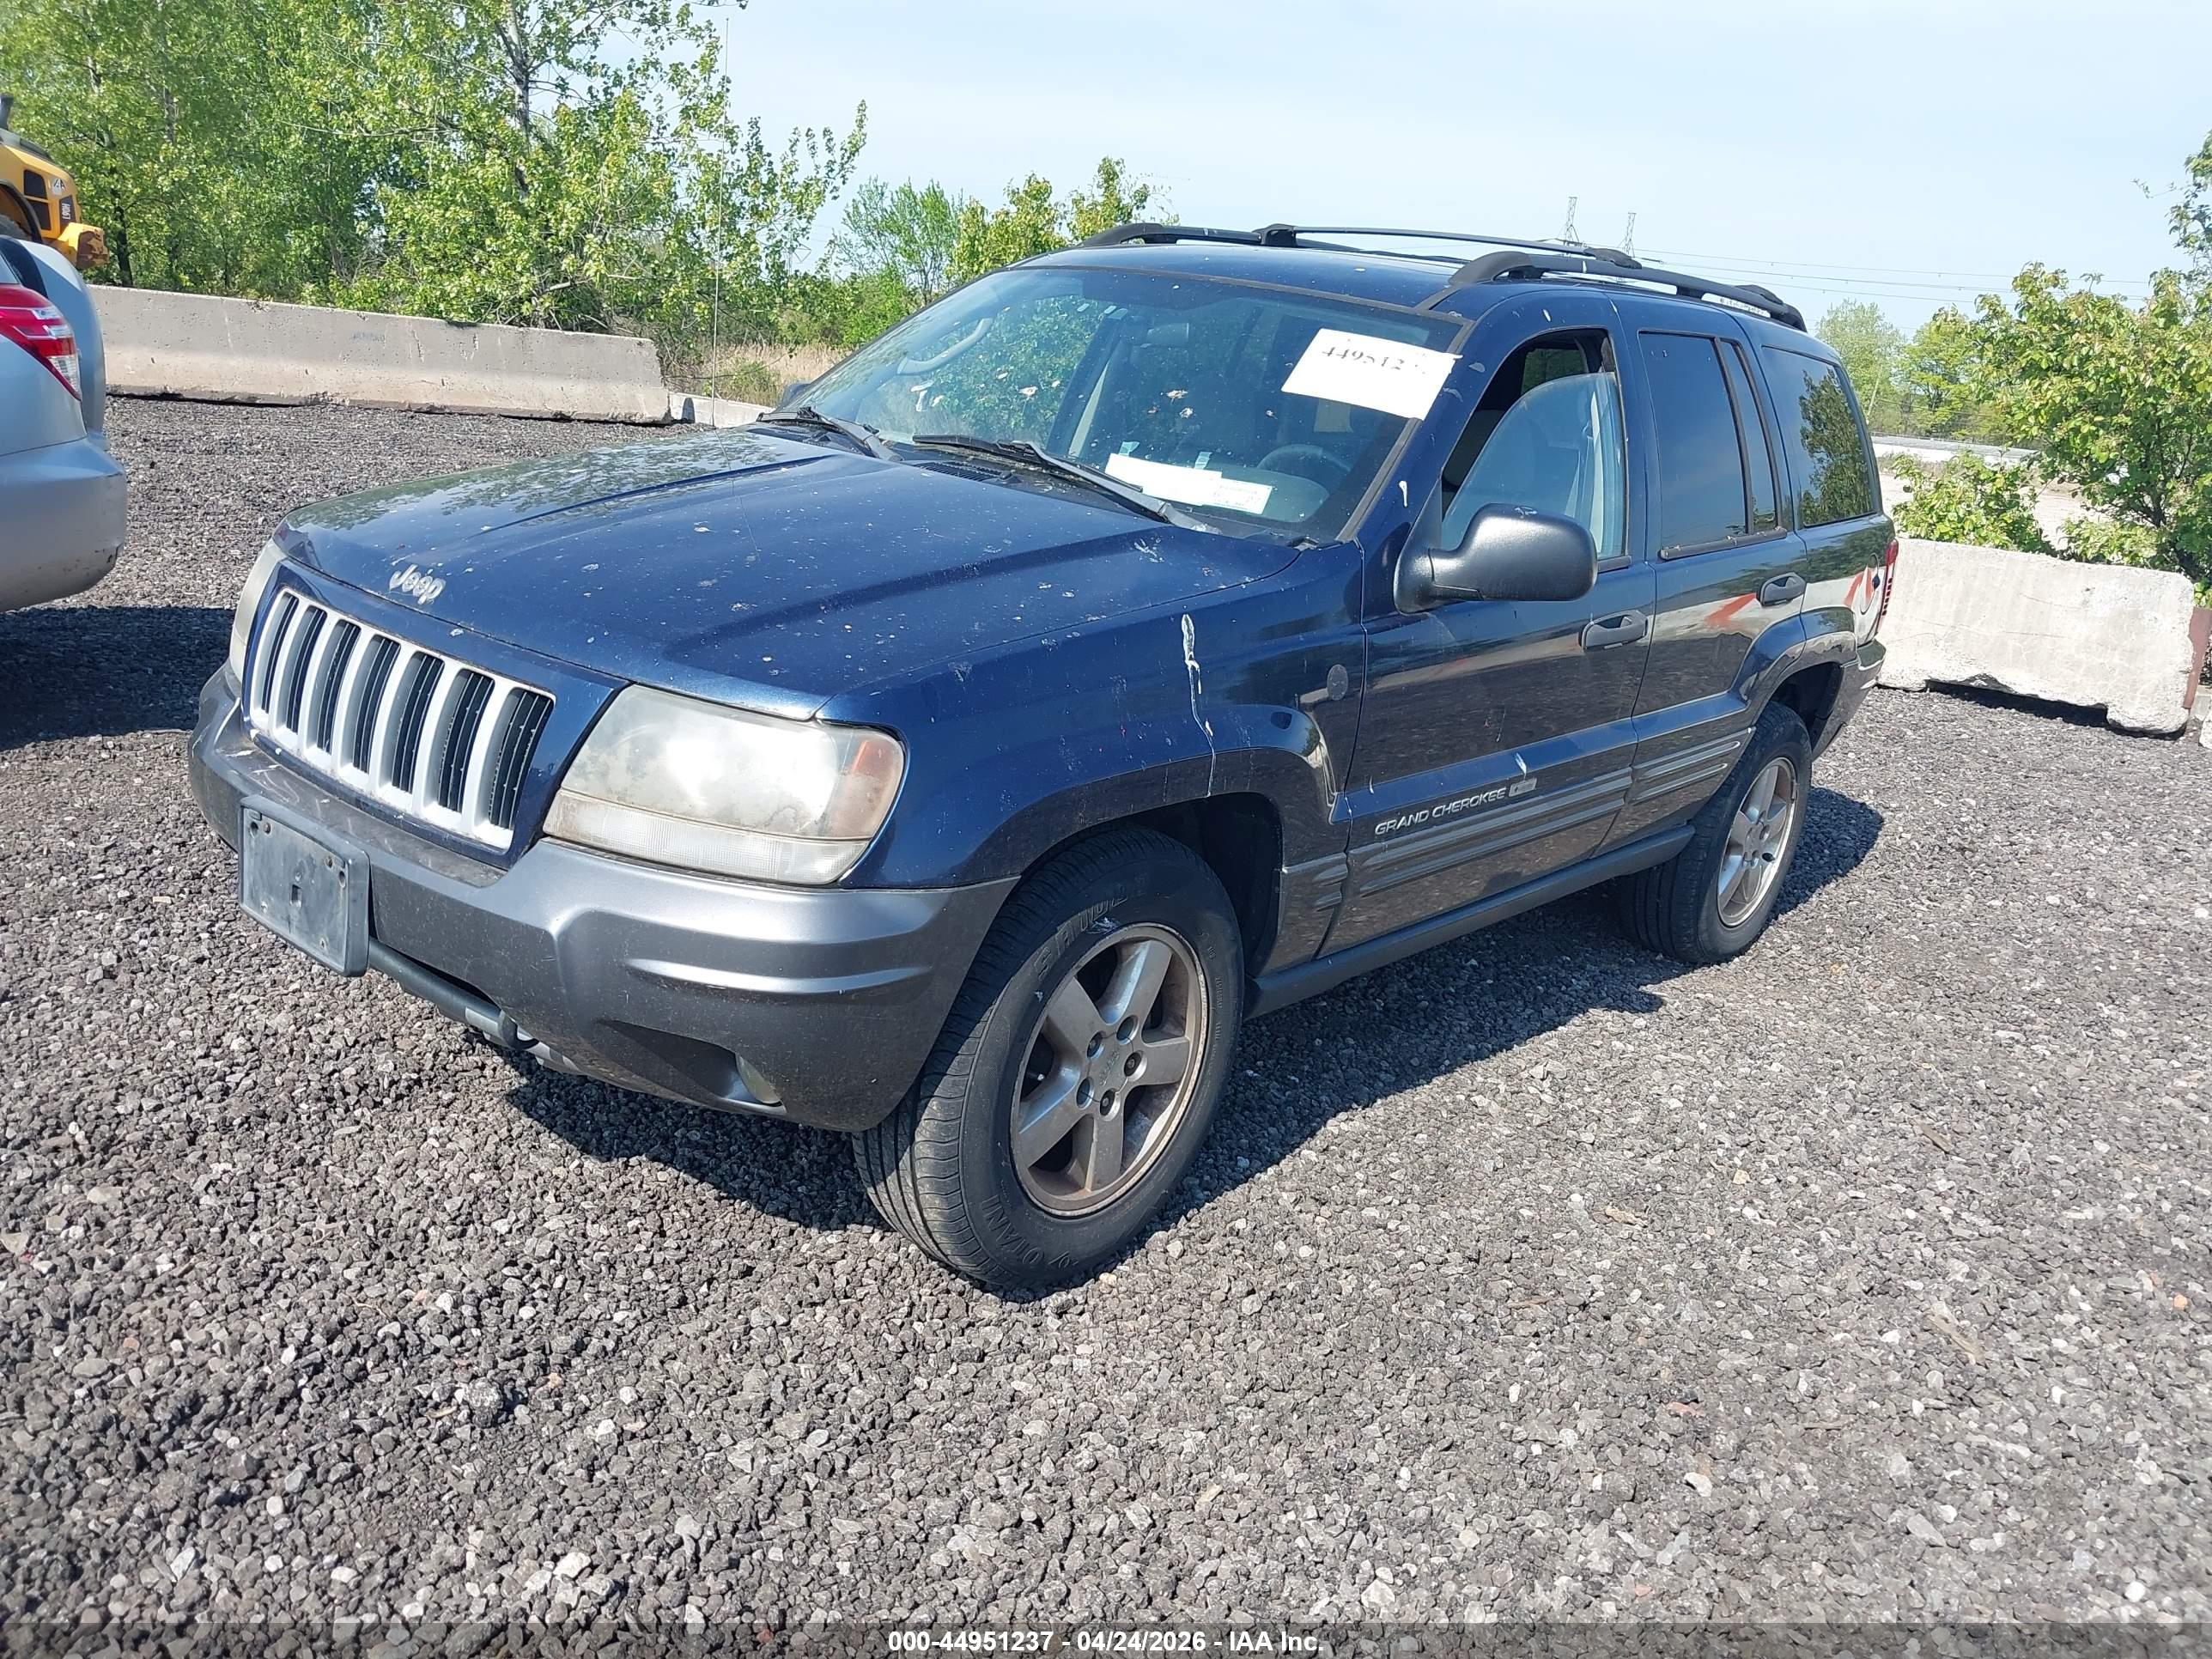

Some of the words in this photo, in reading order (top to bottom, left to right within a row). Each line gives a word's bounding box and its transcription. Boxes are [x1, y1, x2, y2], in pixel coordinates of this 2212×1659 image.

[389, 564, 447, 605] Jeep
[1375, 810, 1429, 836] GRAND
[1431, 787, 1507, 818] CHEROKEE
